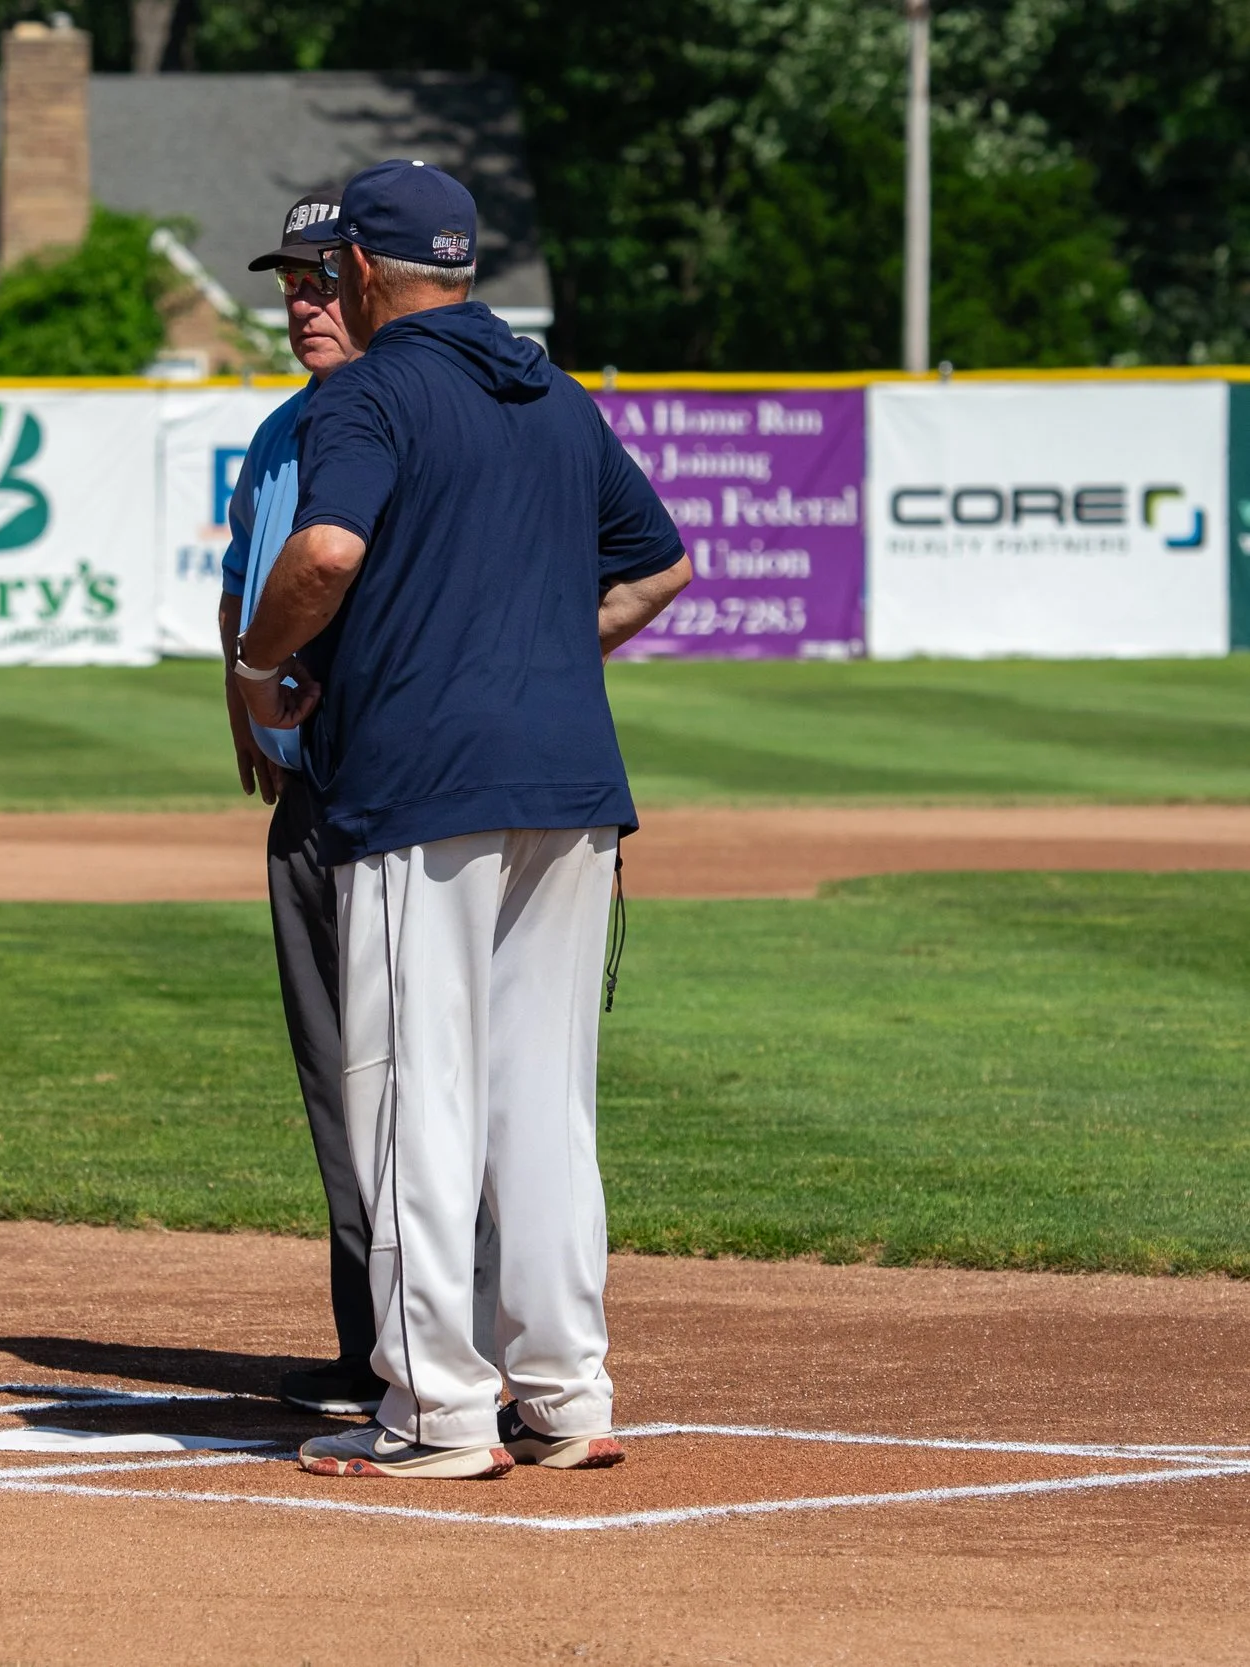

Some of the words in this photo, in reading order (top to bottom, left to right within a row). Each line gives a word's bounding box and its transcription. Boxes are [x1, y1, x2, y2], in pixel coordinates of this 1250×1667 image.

[432, 236, 452, 249] GREAT
[652, 400, 752, 436] Home
[757, 400, 824, 436] Run
[658, 442, 773, 483] Joining
[721, 485, 859, 527] Federal
[889, 485, 1128, 527] CORE
[693, 538, 812, 580] Union
